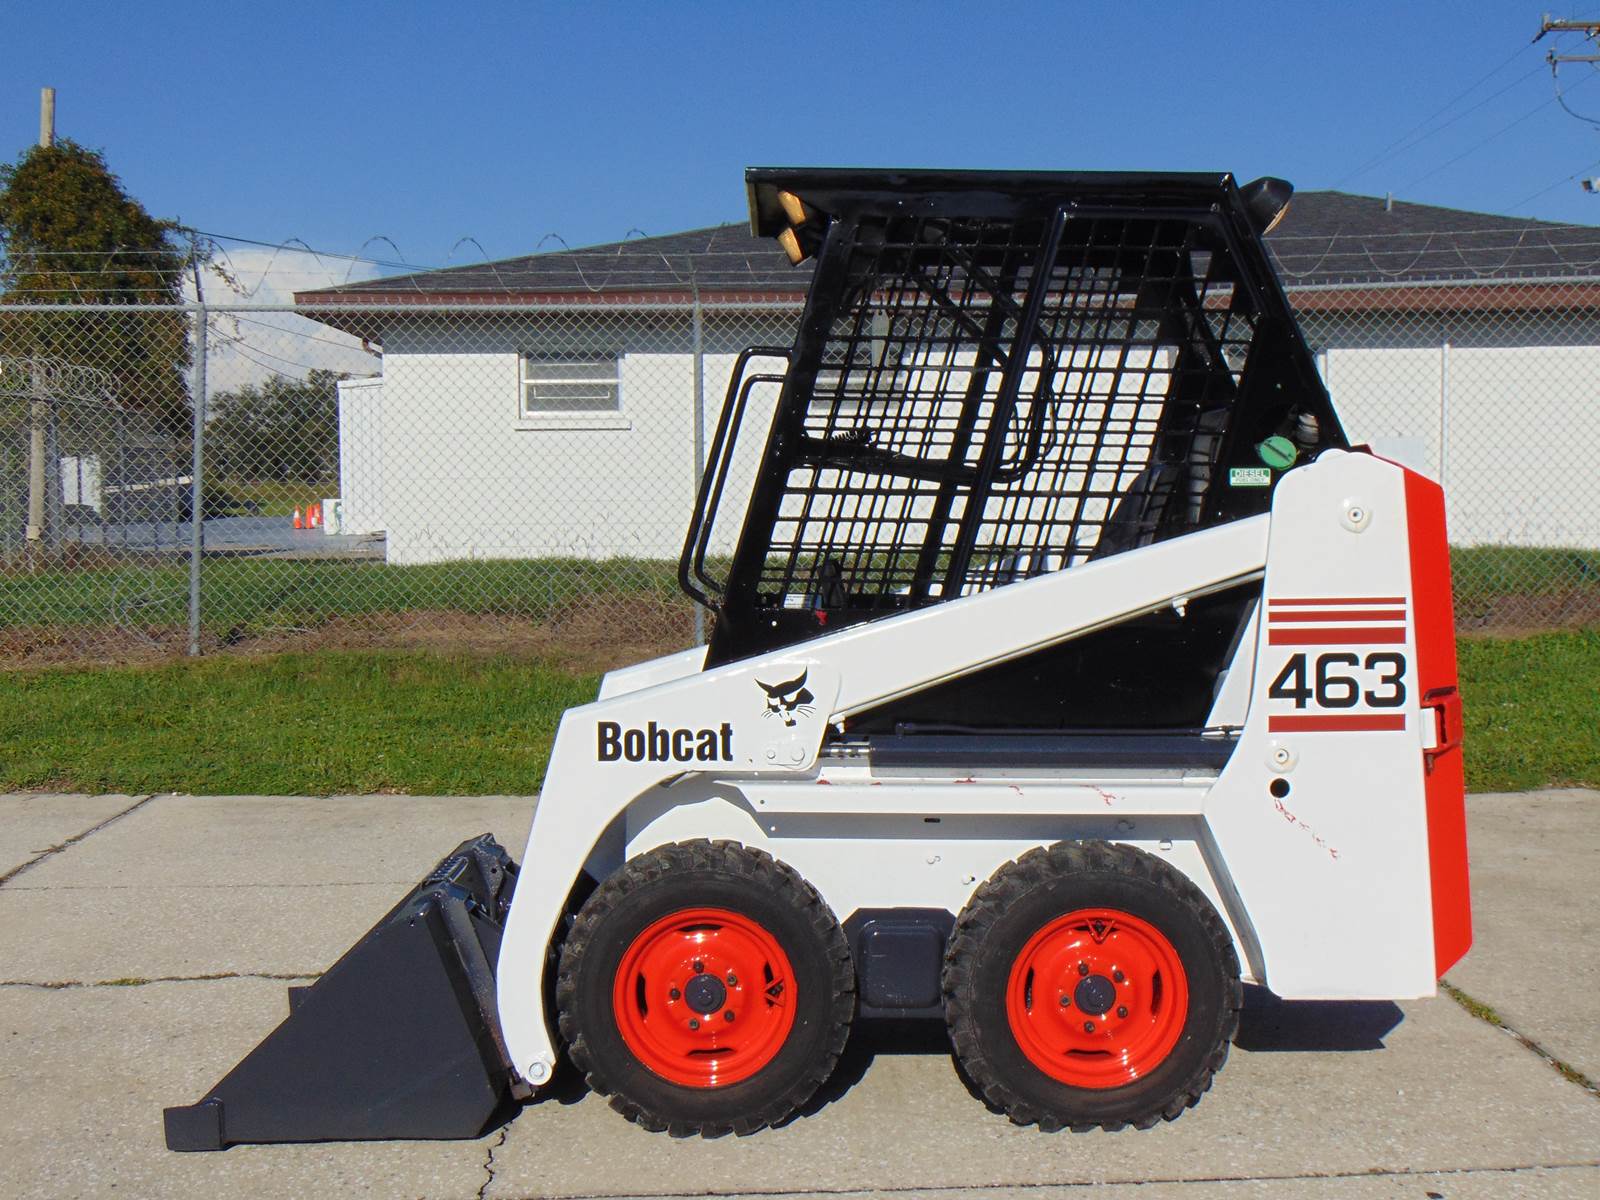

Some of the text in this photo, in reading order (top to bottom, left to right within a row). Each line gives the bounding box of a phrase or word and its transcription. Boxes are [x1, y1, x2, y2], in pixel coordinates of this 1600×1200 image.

[1235, 469, 1265, 478] DIESEL
[1268, 652, 1406, 709] 463
[597, 721, 733, 762] Bobcat
